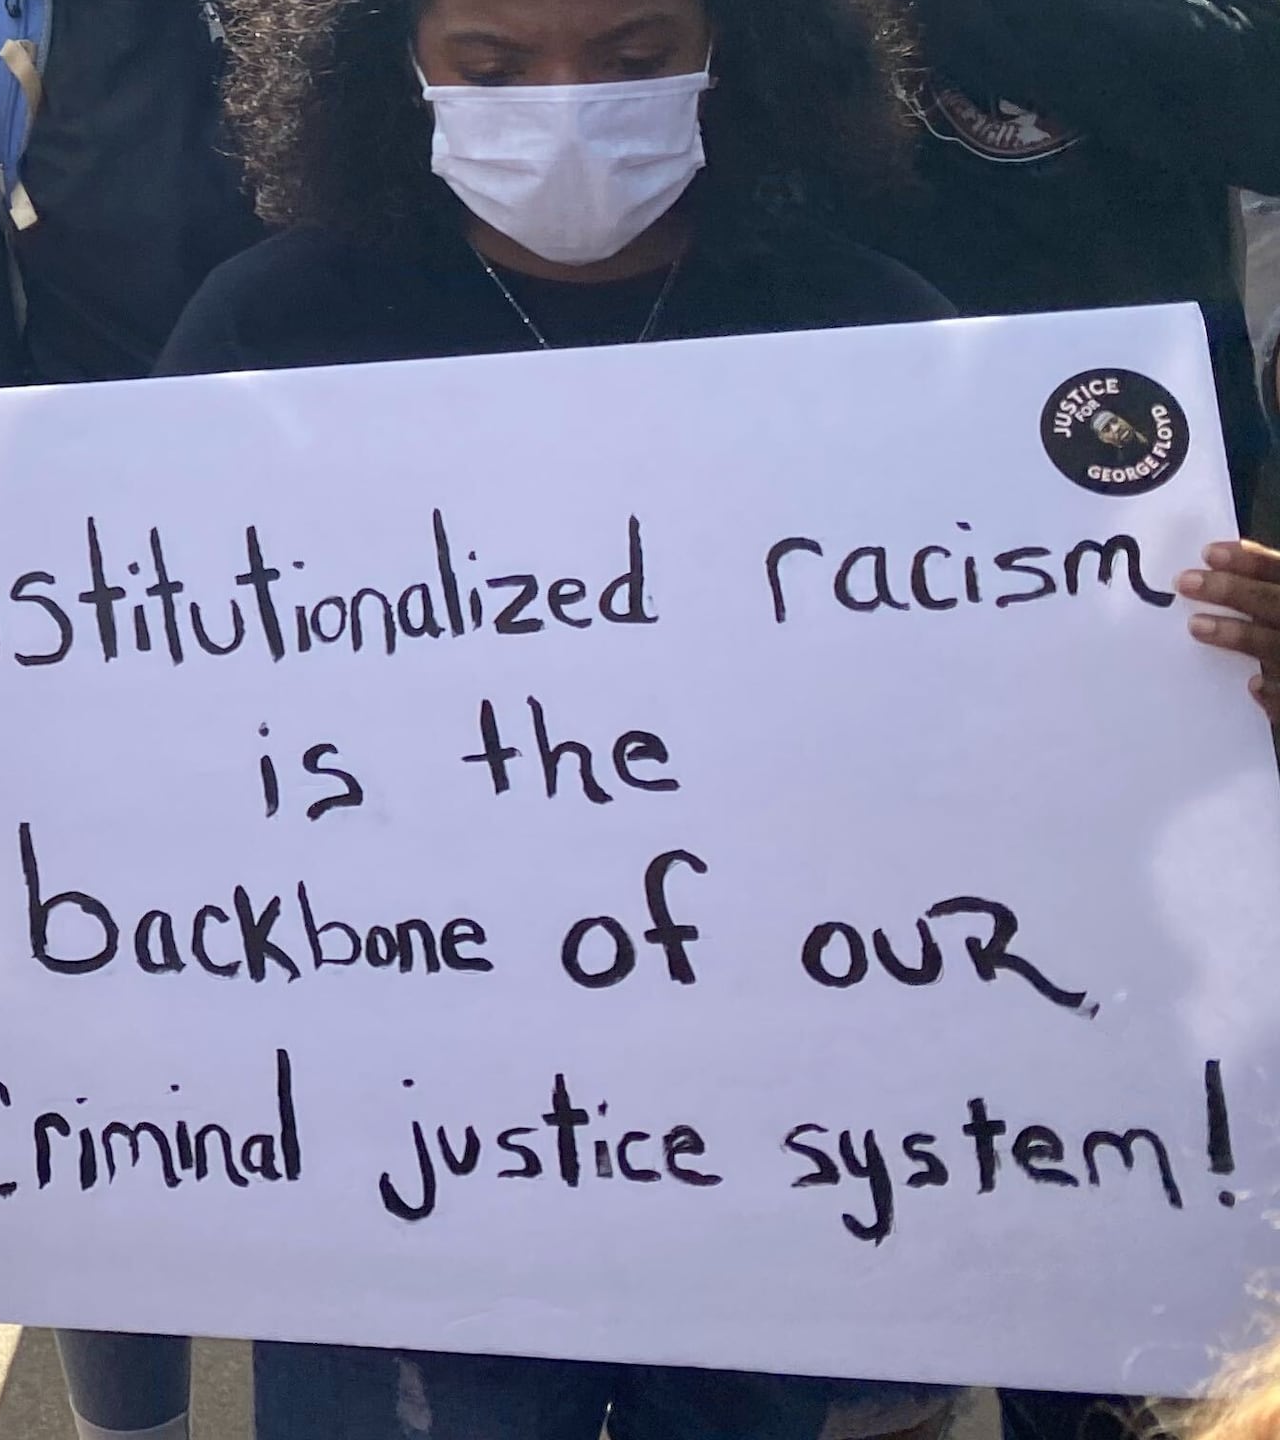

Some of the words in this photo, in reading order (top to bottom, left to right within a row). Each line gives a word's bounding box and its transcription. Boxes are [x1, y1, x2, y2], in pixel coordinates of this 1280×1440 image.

[1053, 377, 1120, 439] JUSTICE
[1074, 399, 1101, 423] FOR
[1087, 455, 1161, 483] GEORGE
[1151, 404, 1174, 459] FLOYD
[765, 521, 1177, 625] racism
[258, 721, 364, 822] is
[460, 695, 681, 805] the
[18, 821, 495, 984] backbone
[560, 849, 709, 989] of
[378, 1072, 724, 1221] justice
[782, 1058, 1236, 1247] system!
